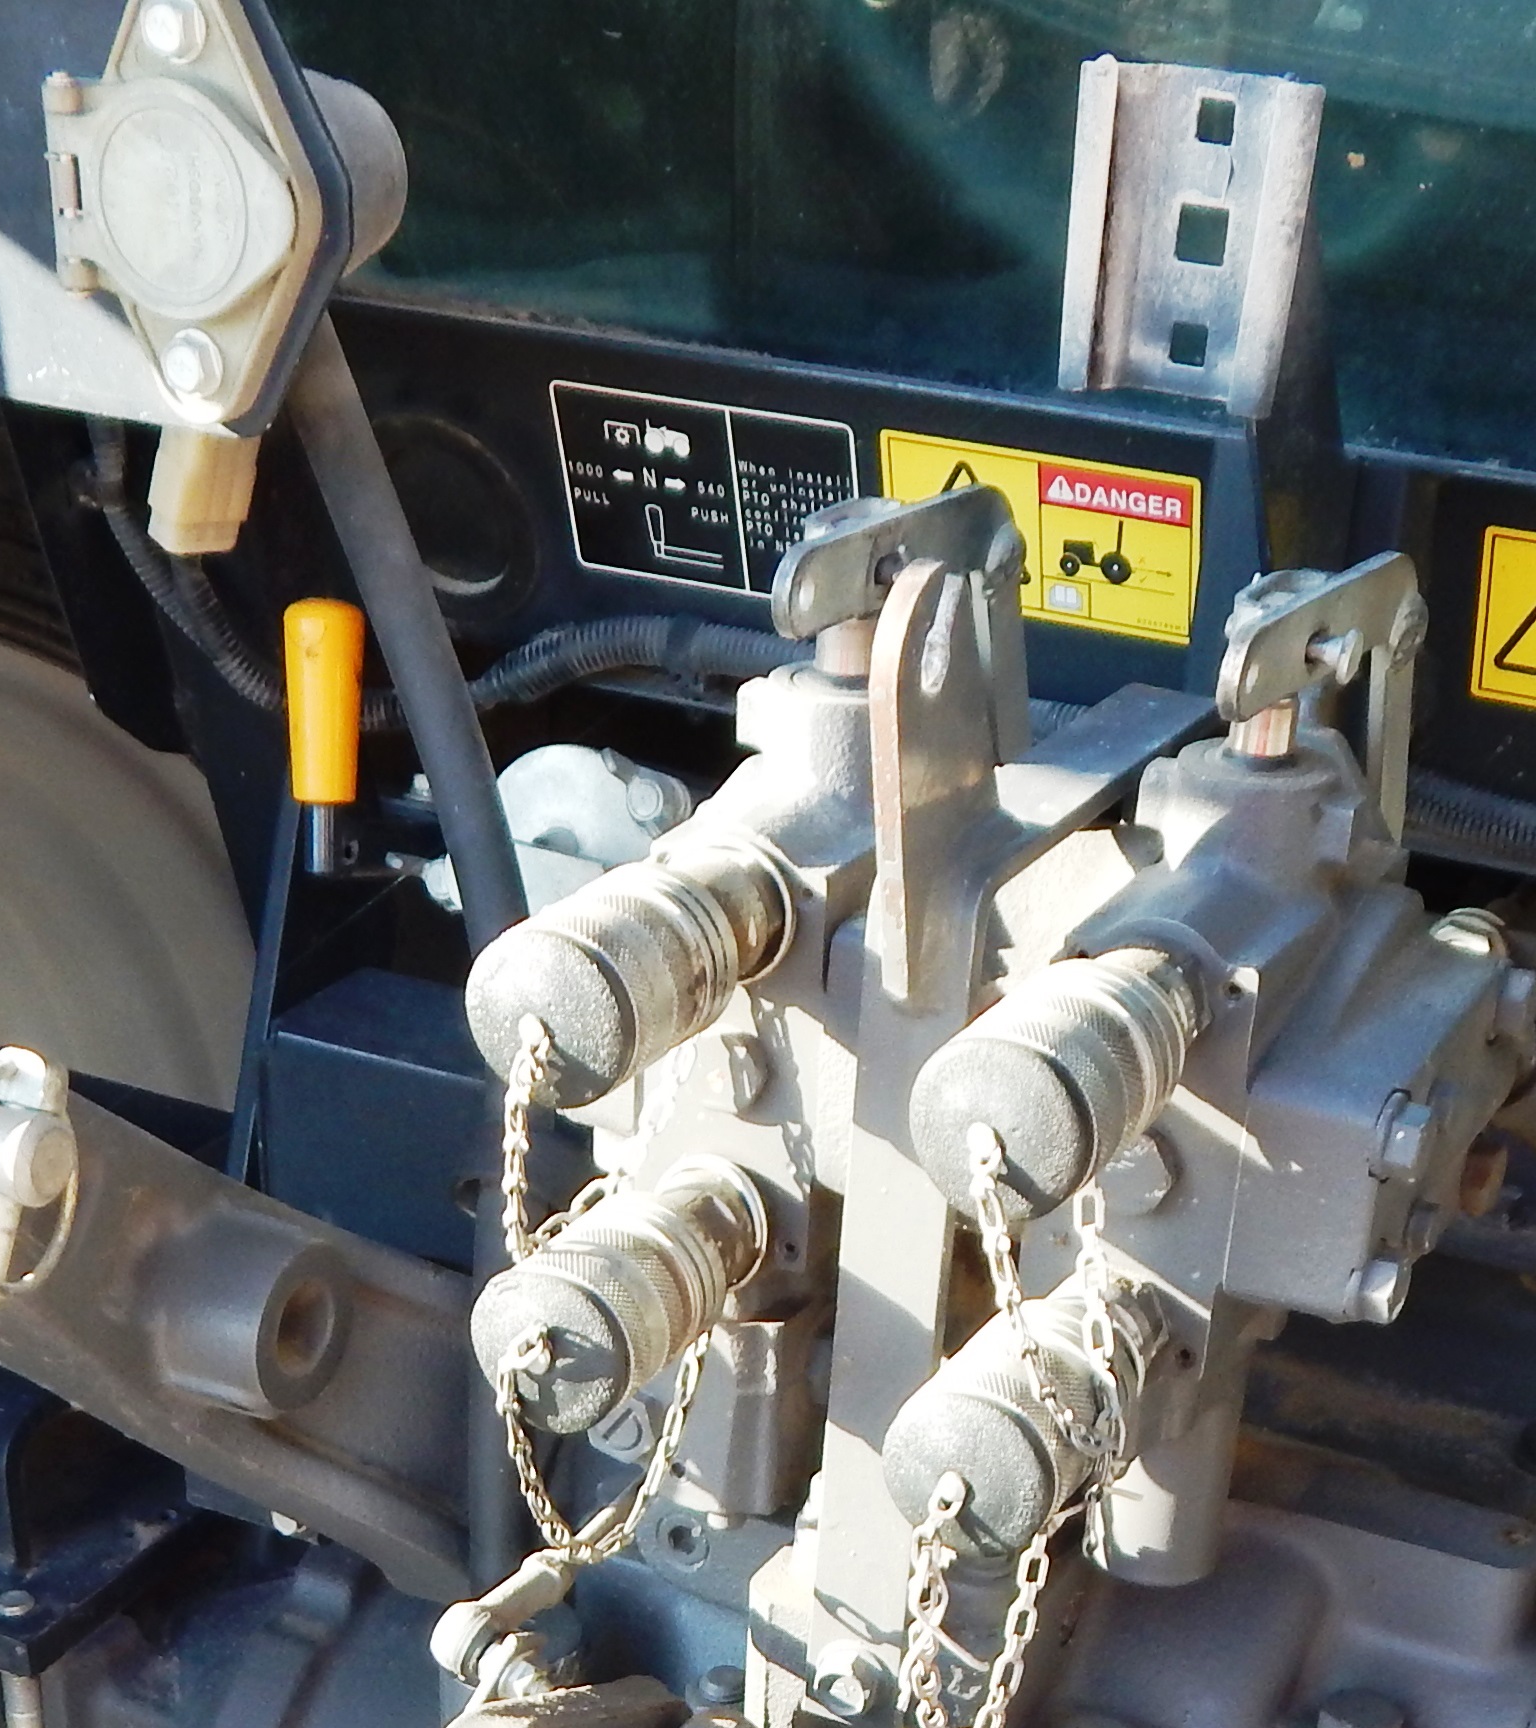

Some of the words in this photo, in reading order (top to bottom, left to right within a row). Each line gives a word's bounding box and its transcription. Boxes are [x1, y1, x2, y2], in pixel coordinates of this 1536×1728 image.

[568, 459, 604, 479] 1000
[642, 466, 657, 489] N
[737, 458, 776, 476] When
[741, 477, 757, 489] or
[573, 486, 611, 507] PULL
[742, 489, 770, 507] PTO
[1074, 482, 1183, 519] DANGER
[690, 506, 730, 525] PUSH
[745, 519, 774, 537] PTO
